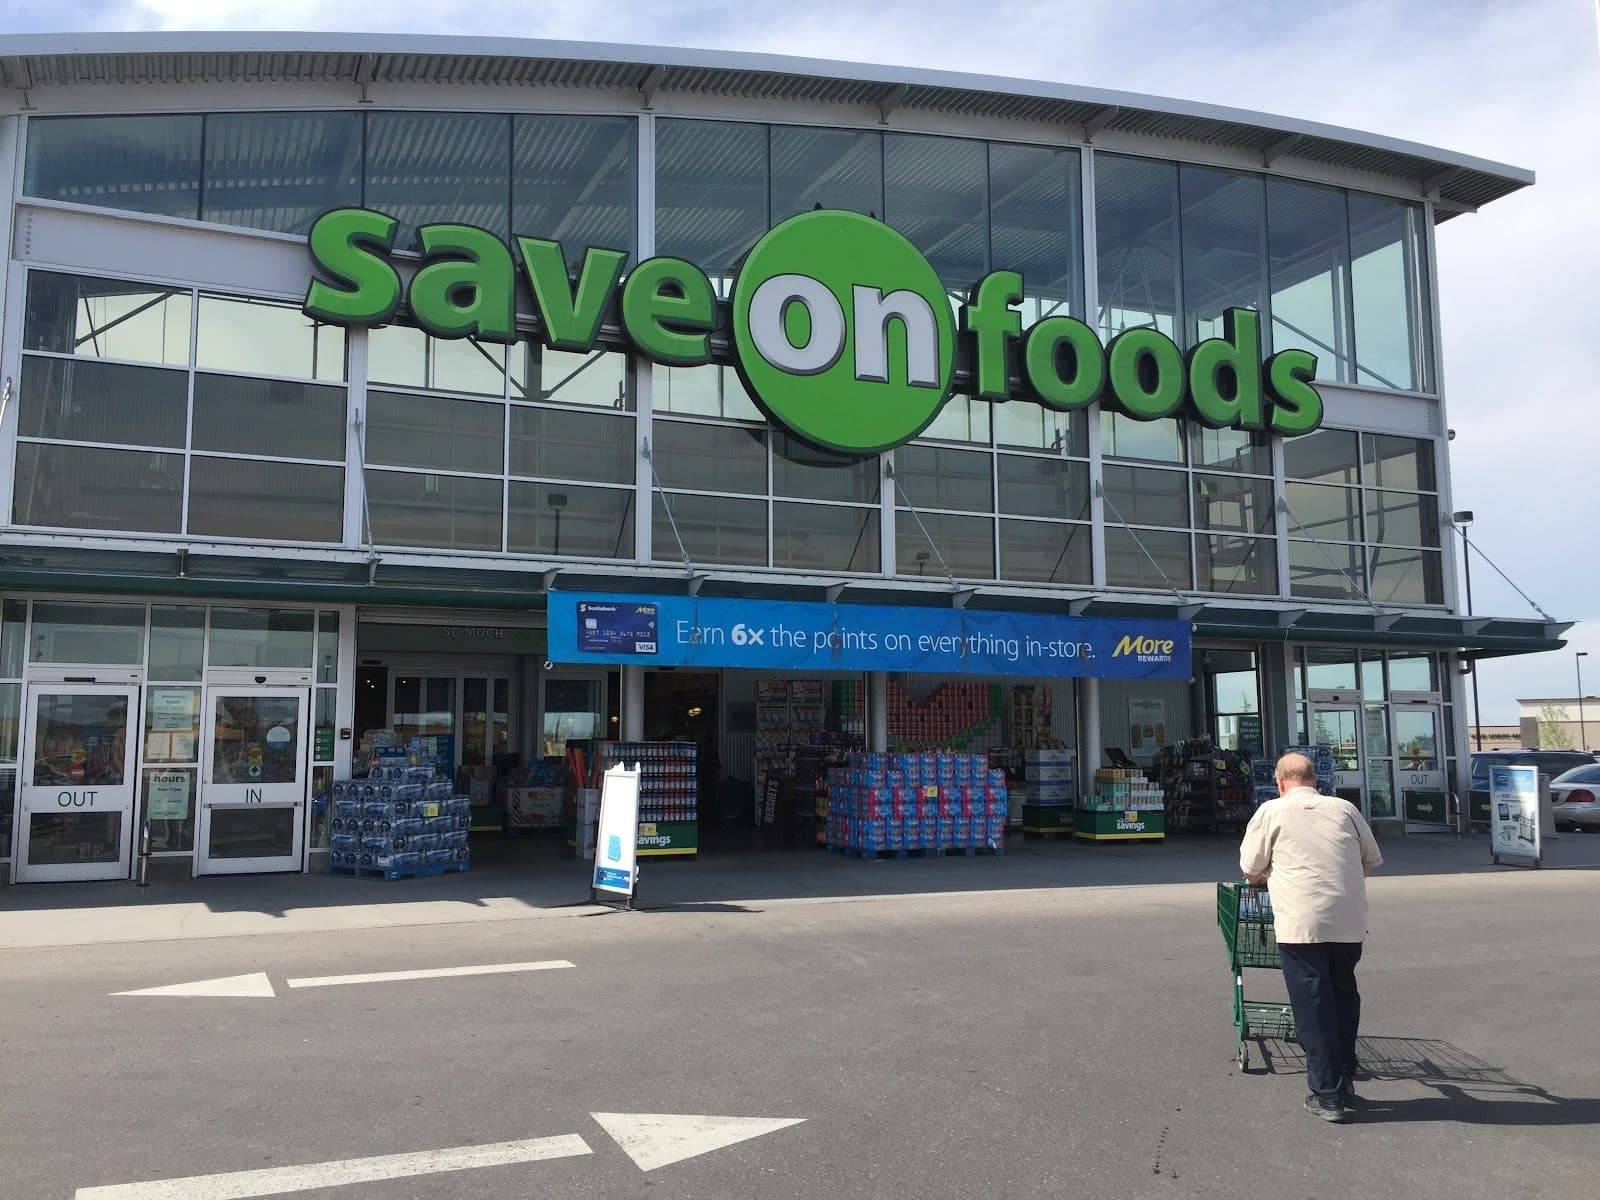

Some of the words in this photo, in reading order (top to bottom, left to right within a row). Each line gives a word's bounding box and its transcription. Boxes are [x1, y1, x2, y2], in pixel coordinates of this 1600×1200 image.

[302, 206, 718, 367] save
[748, 273, 940, 390] on
[960, 269, 1324, 437] foods
[443, 626, 461, 637] SO
[465, 626, 504, 638] MUCH
[676, 619, 725, 645] Earn
[731, 623, 765, 646] 6x
[770, 623, 807, 648] the
[813, 625, 877, 653] points
[884, 633, 911, 651] on
[918, 631, 1019, 662] everything
[1025, 634, 1097, 659] in-store.
[1112, 635, 1174, 658] More
[153, 773, 186, 783] hours
[1410, 774, 1428, 785] OUT
[57, 791, 98, 807] OUT
[245, 788, 262, 803] IN
[764, 779, 779, 823] HERSHEY'S
[1116, 822, 1145, 831] savings
[637, 835, 671, 847] avings
